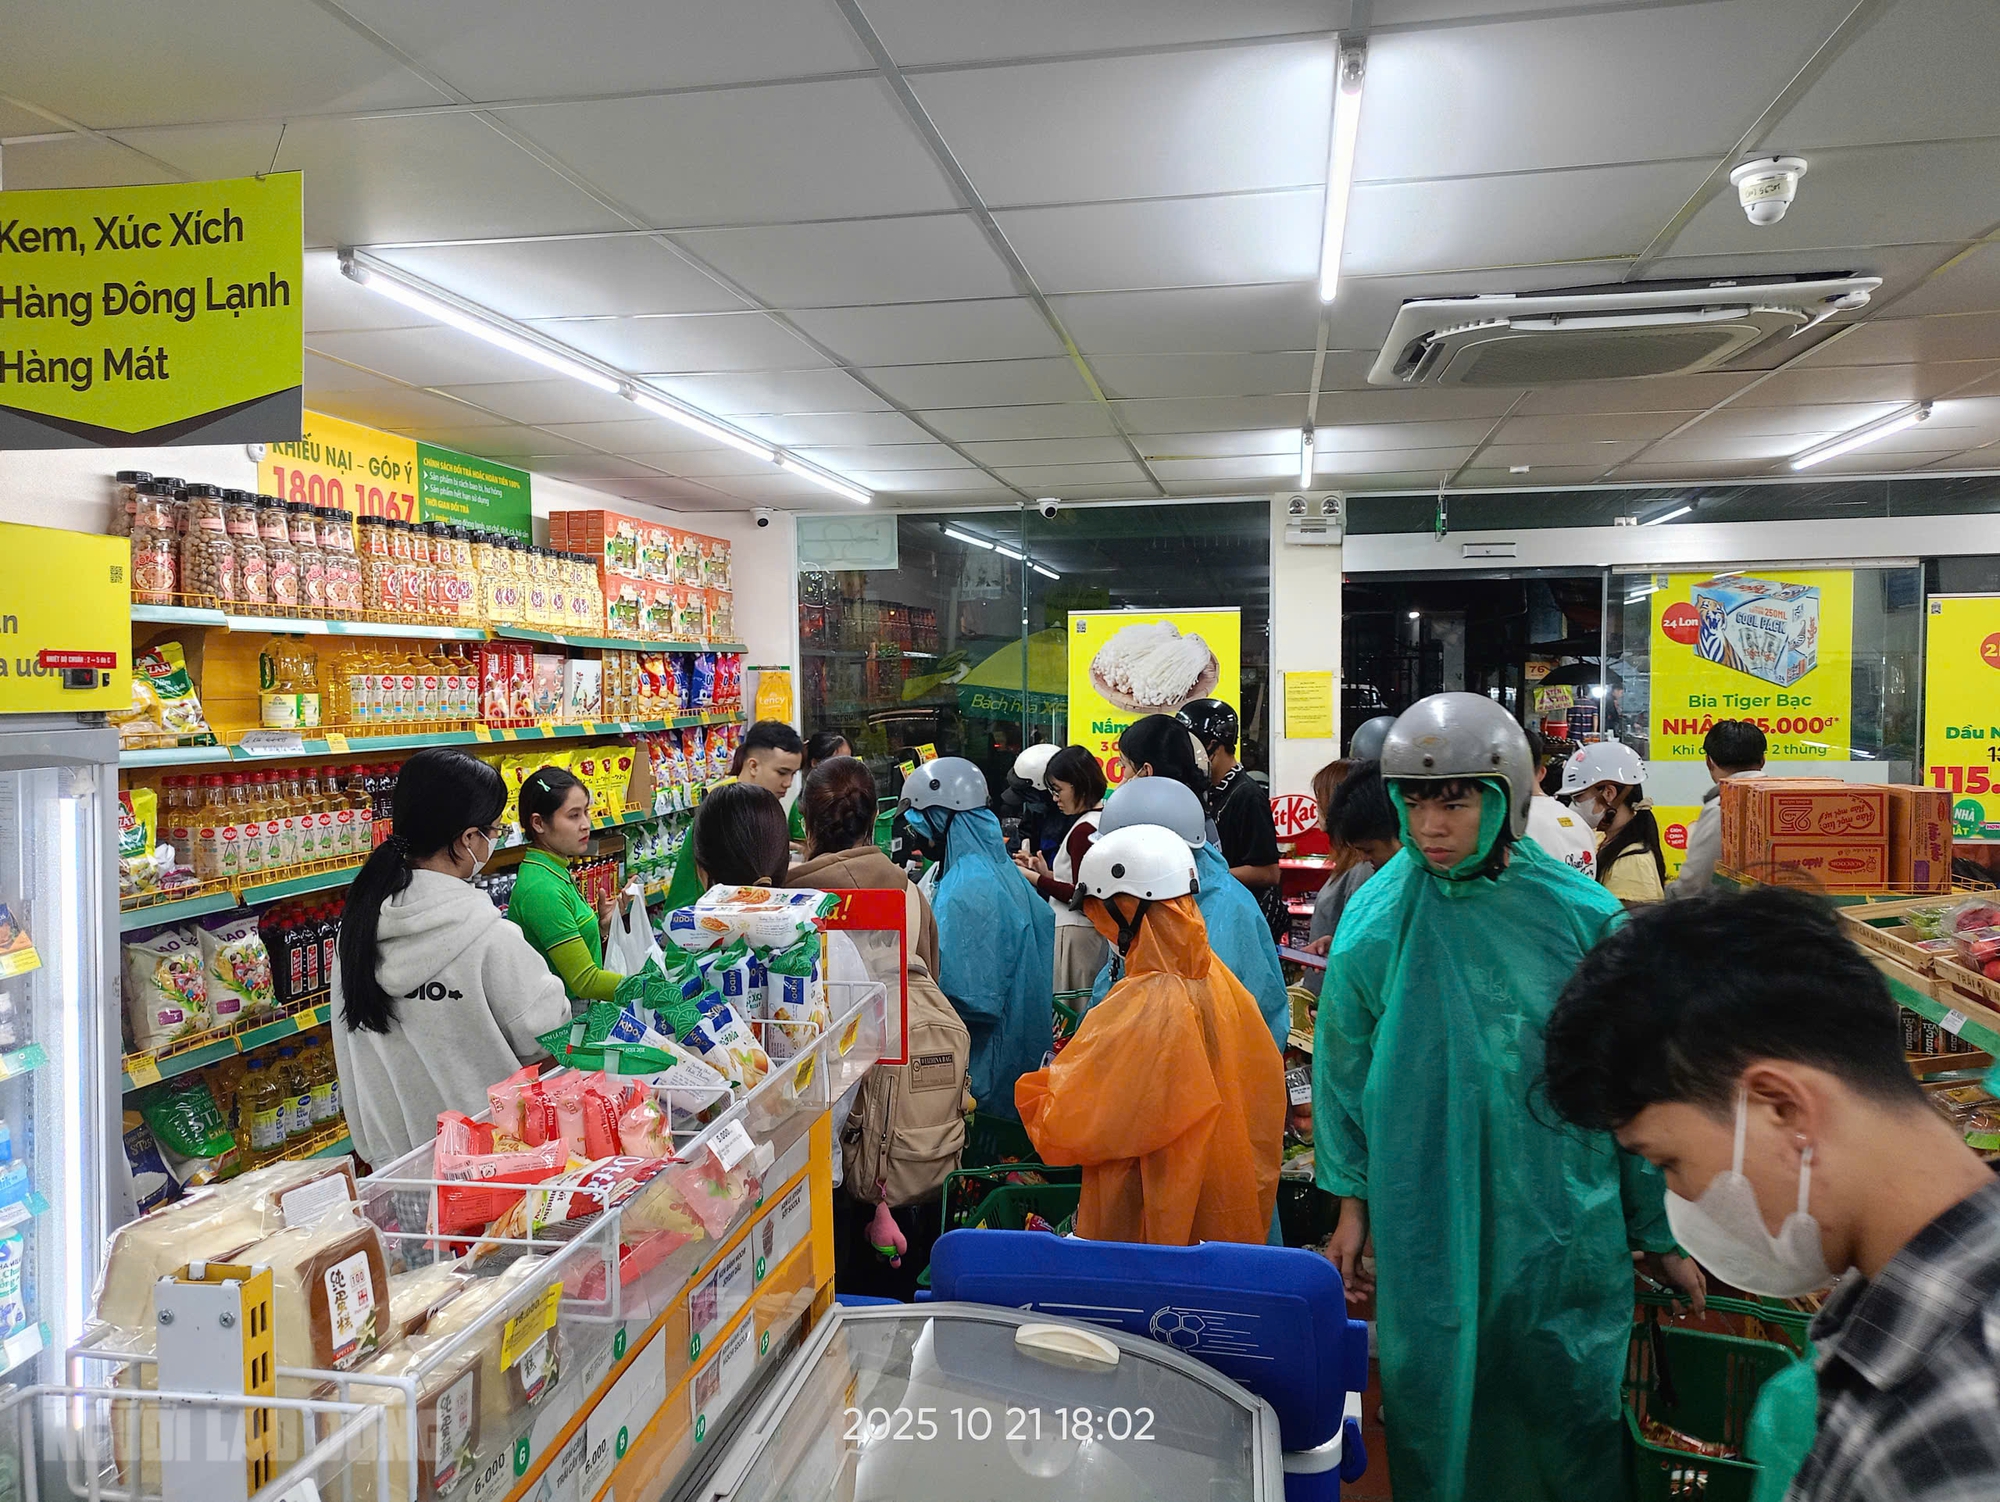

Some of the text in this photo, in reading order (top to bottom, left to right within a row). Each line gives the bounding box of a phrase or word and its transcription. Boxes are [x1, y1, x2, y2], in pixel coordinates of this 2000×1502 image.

[0, 208, 243, 257] Kem, Xúc Xích
[0, 272, 290, 327] Hàng Đông Lạnh
[0, 346, 169, 392] Hàng Mát
[326, 449, 352, 475] NẠI
[369, 454, 400, 481] GÓP
[404, 460, 412, 484] Ý
[273, 466, 414, 523] 1800 1067
[1764, 608, 1788, 620] 250ML
[0, 614, 18, 634] n
[1663, 617, 1699, 628] 24 Lon
[1529, 665, 1545, 673] 76
[759, 694, 786, 708] Lency
[971, 694, 1007, 713] Bách
[1688, 693, 1812, 710] Bia Tiger Bạc
[1945, 724, 1985, 739] Dầu
[1101, 741, 1108, 751] 3
[1672, 744, 1694, 755] Khi
[1772, 745, 1780, 755] 2
[1953, 808, 1976, 822] NHÀ
[617, 1021, 641, 1037] KIDO
[518, 1449, 526, 1464] 6
[584, 1438, 607, 1475] 6.000
[474, 1452, 506, 1495] 6.000
